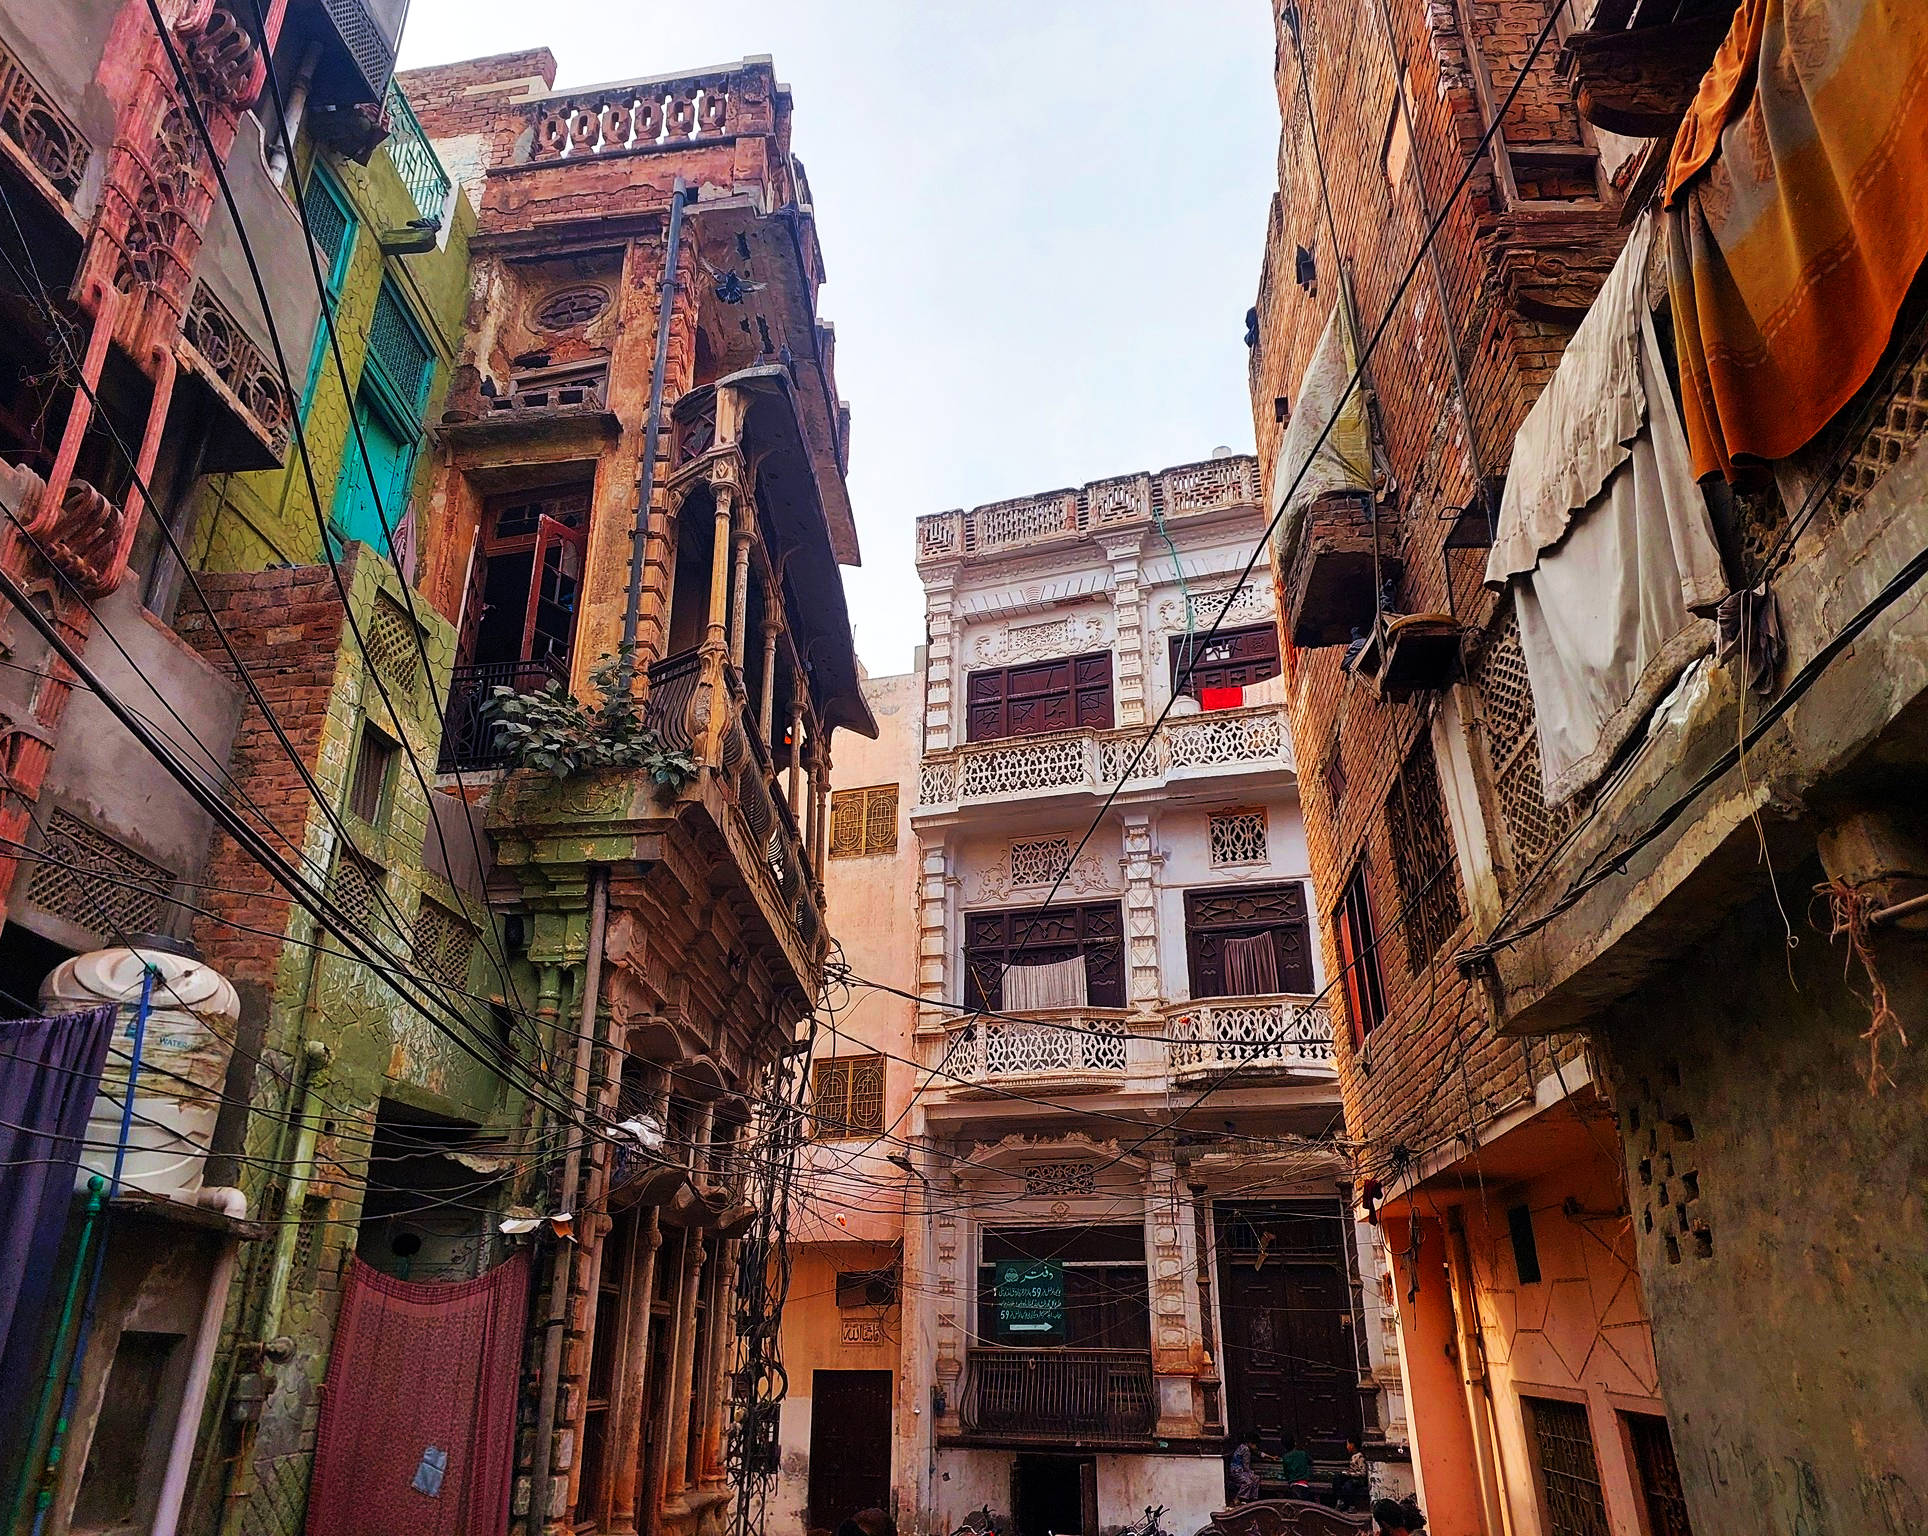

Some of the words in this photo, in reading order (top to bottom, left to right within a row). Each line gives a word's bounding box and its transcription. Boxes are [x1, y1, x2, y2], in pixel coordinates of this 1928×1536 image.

[1019, 1266, 1054, 1284] دفتر
[1031, 1287, 1042, 1297] 59
[1000, 1310, 1009, 1320] 59
